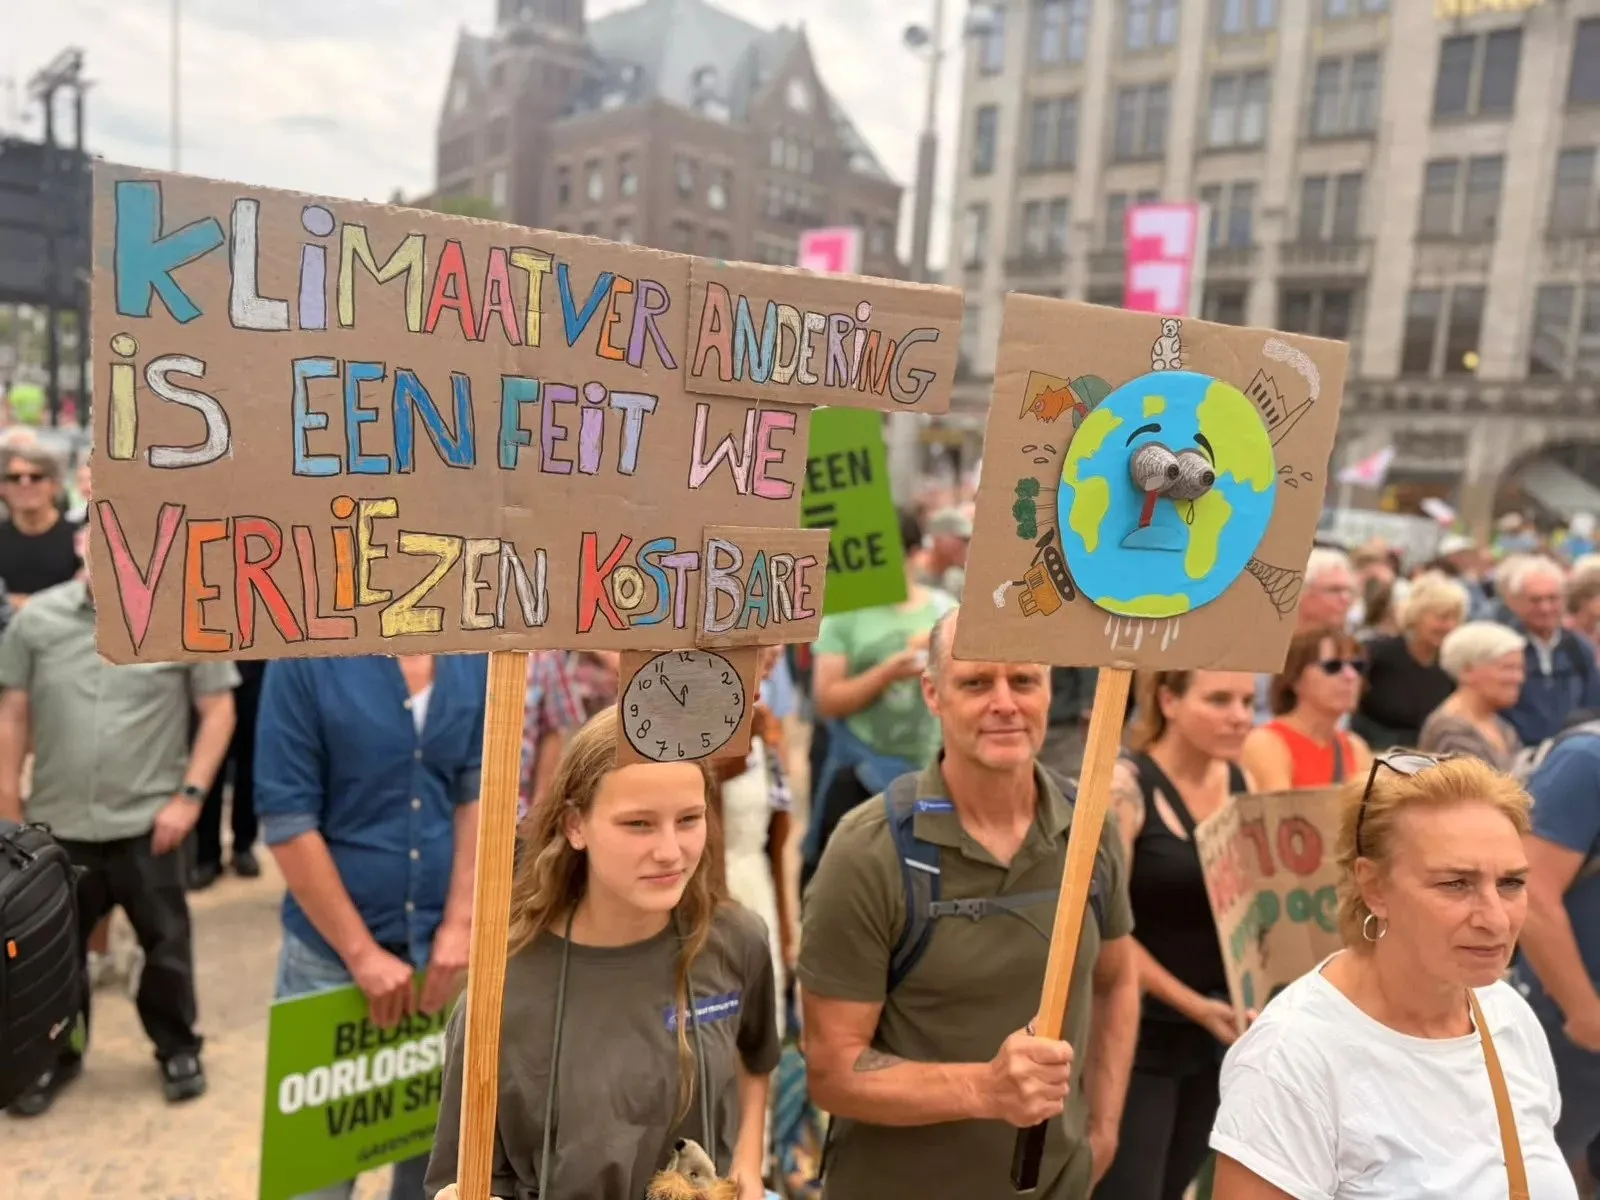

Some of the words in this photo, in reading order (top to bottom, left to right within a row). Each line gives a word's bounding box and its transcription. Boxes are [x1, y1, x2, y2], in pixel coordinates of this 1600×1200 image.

[291, 356, 477, 477] EEN
[687, 402, 798, 500] WE
[803, 447, 874, 494] EEN
[826, 532, 888, 574] ACE
[678, 651, 695, 663] 12
[655, 661, 665, 673] 11
[638, 679, 652, 691] 10
[720, 671, 734, 686] 2
[731, 692, 741, 706] 3
[630, 703, 639, 718] 9
[636, 719, 652, 739] 8
[724, 715, 736, 728] 4
[700, 732, 712, 749] 5
[655, 740, 669, 758] 7
[677, 742, 685, 758] 6
[278, 1031, 446, 1114] OORLOGS
[327, 1090, 394, 1136] VAN
[404, 1072, 442, 1111] SH
